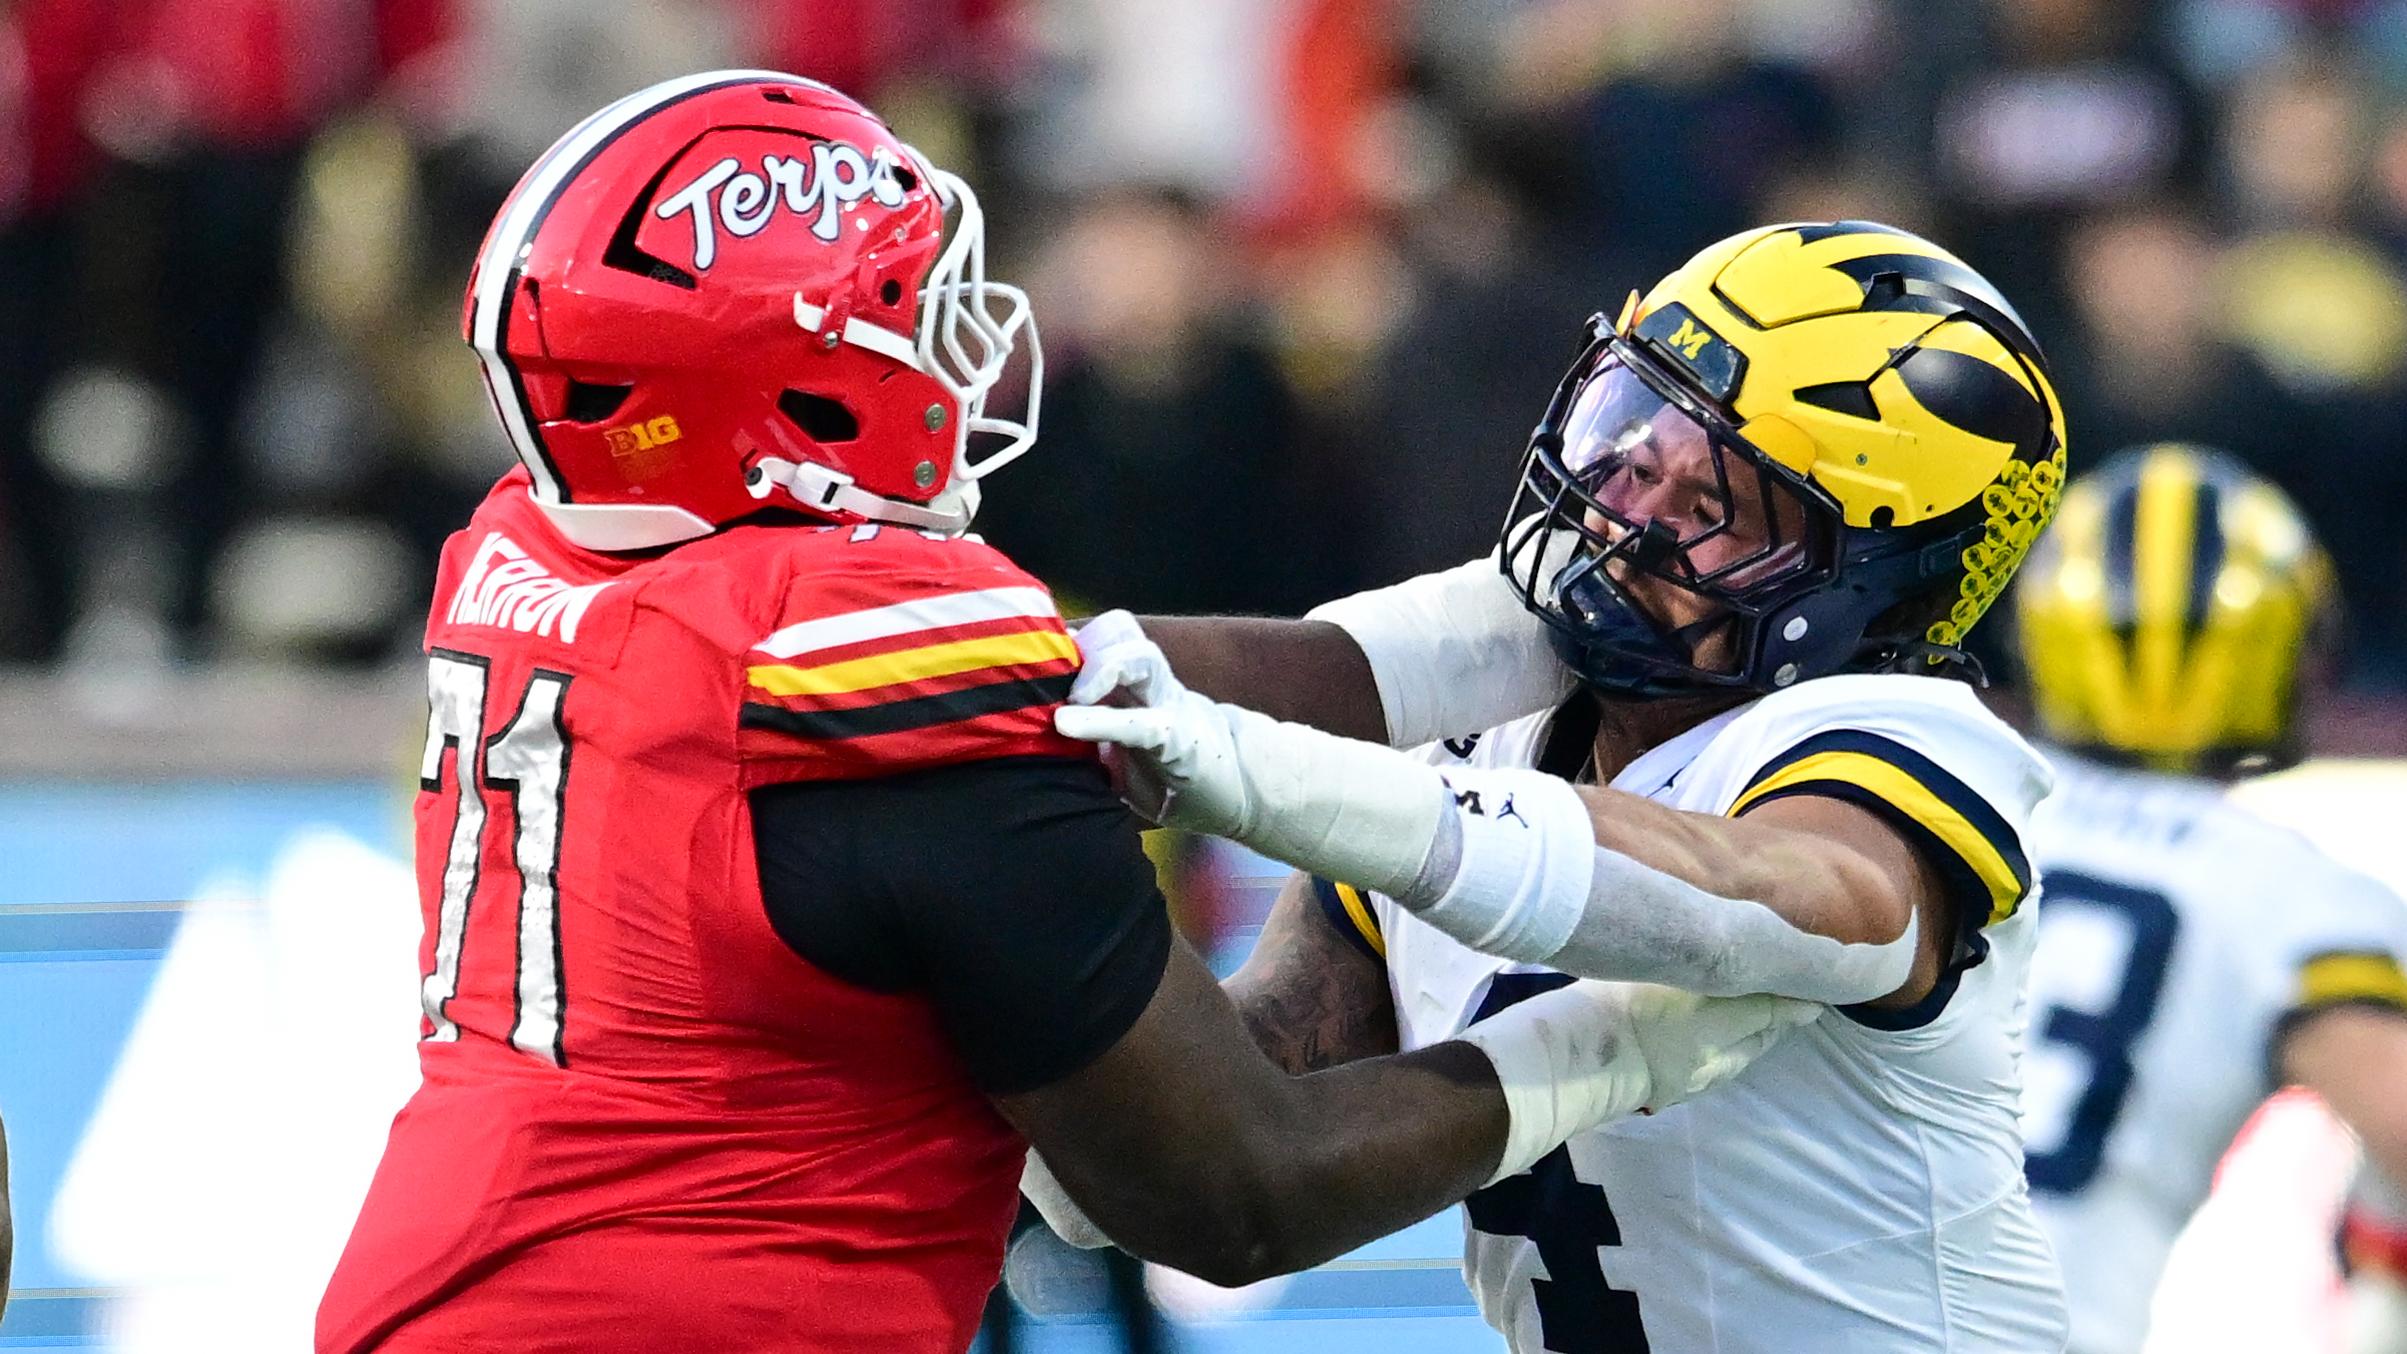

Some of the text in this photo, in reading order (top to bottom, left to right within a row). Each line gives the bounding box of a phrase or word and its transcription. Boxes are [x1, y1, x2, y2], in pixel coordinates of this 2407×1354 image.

[655, 140, 905, 270] Terps
[1667, 318, 1712, 360] M
[420, 646, 574, 1068] 71
